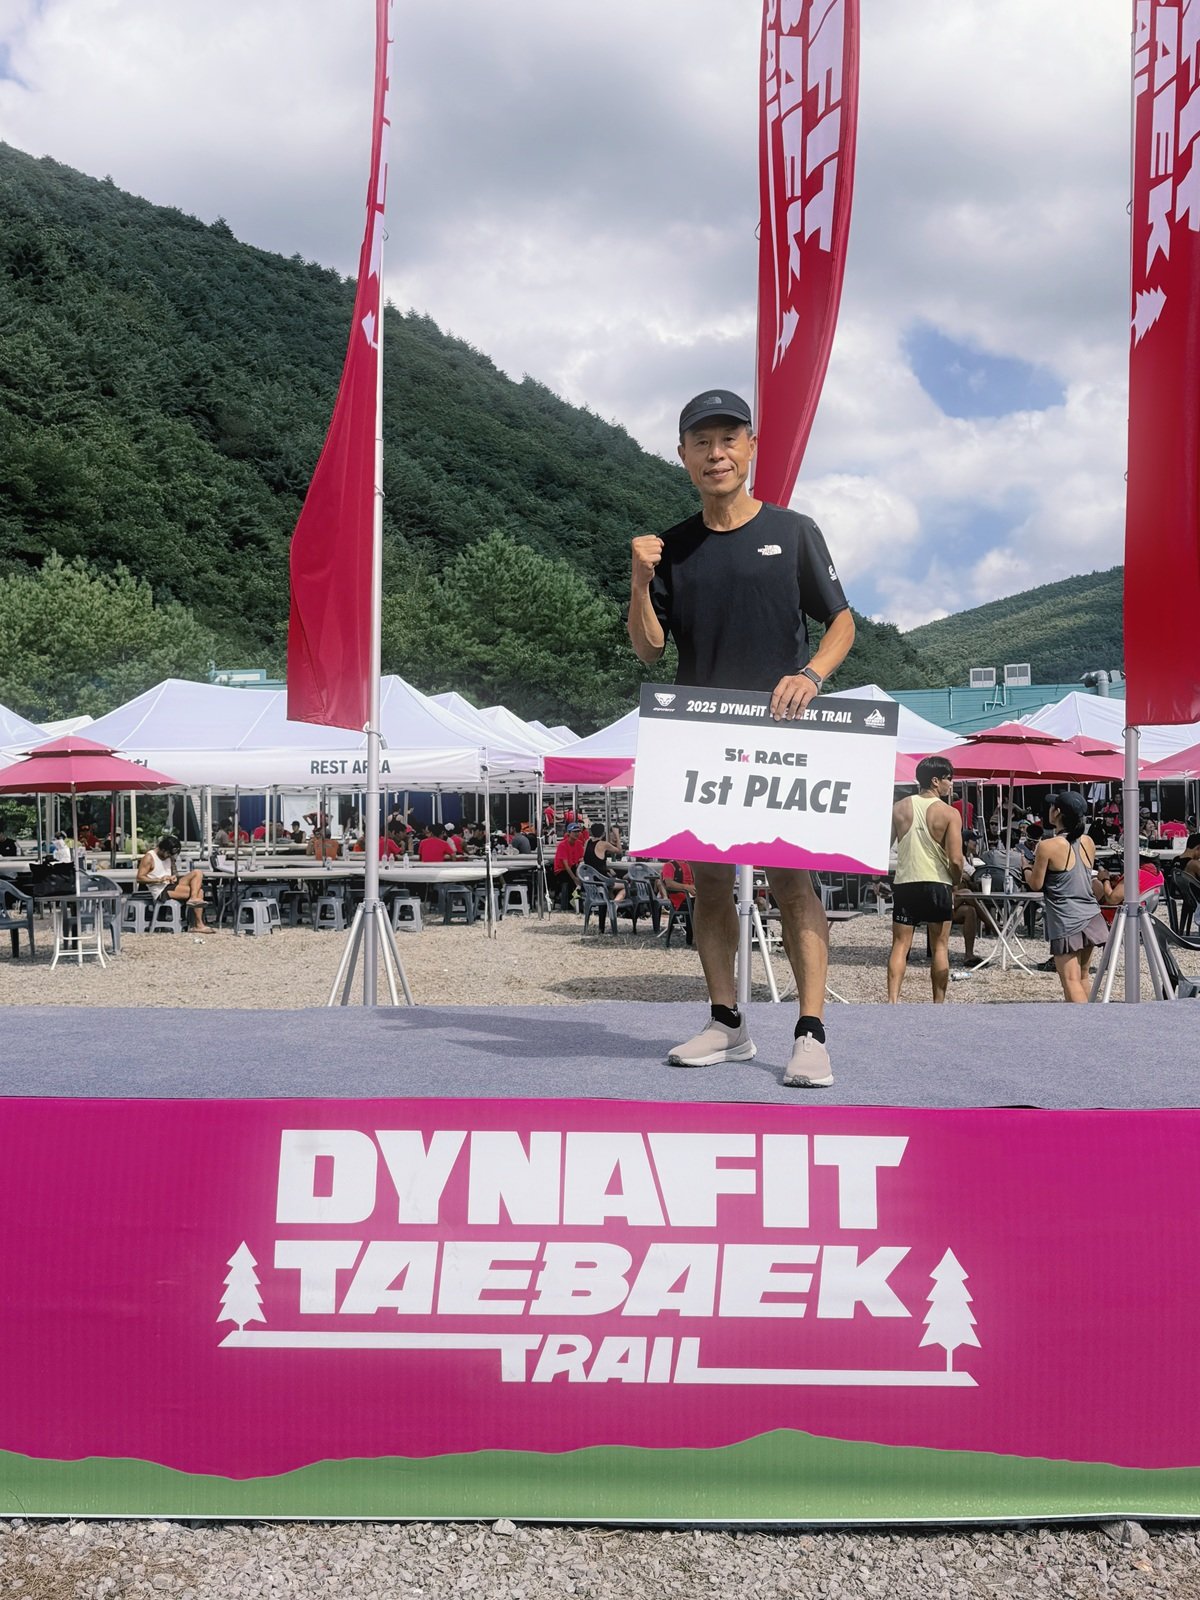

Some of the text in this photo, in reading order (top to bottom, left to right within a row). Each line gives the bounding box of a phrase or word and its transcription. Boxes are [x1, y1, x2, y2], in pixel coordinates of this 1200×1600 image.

[686, 701, 717, 714] 2025
[719, 703, 767, 718] DYNAFIT
[820, 710, 853, 724] TRAIL
[310, 759, 391, 775] REST ARA
[755, 750, 808, 767] RACE
[684, 769, 852, 814] 1st PLACE
[275, 1129, 910, 1230] DYNAFIT
[274, 1240, 913, 1319] TAEBAEK
[500, 1333, 702, 1385] TRAIL
